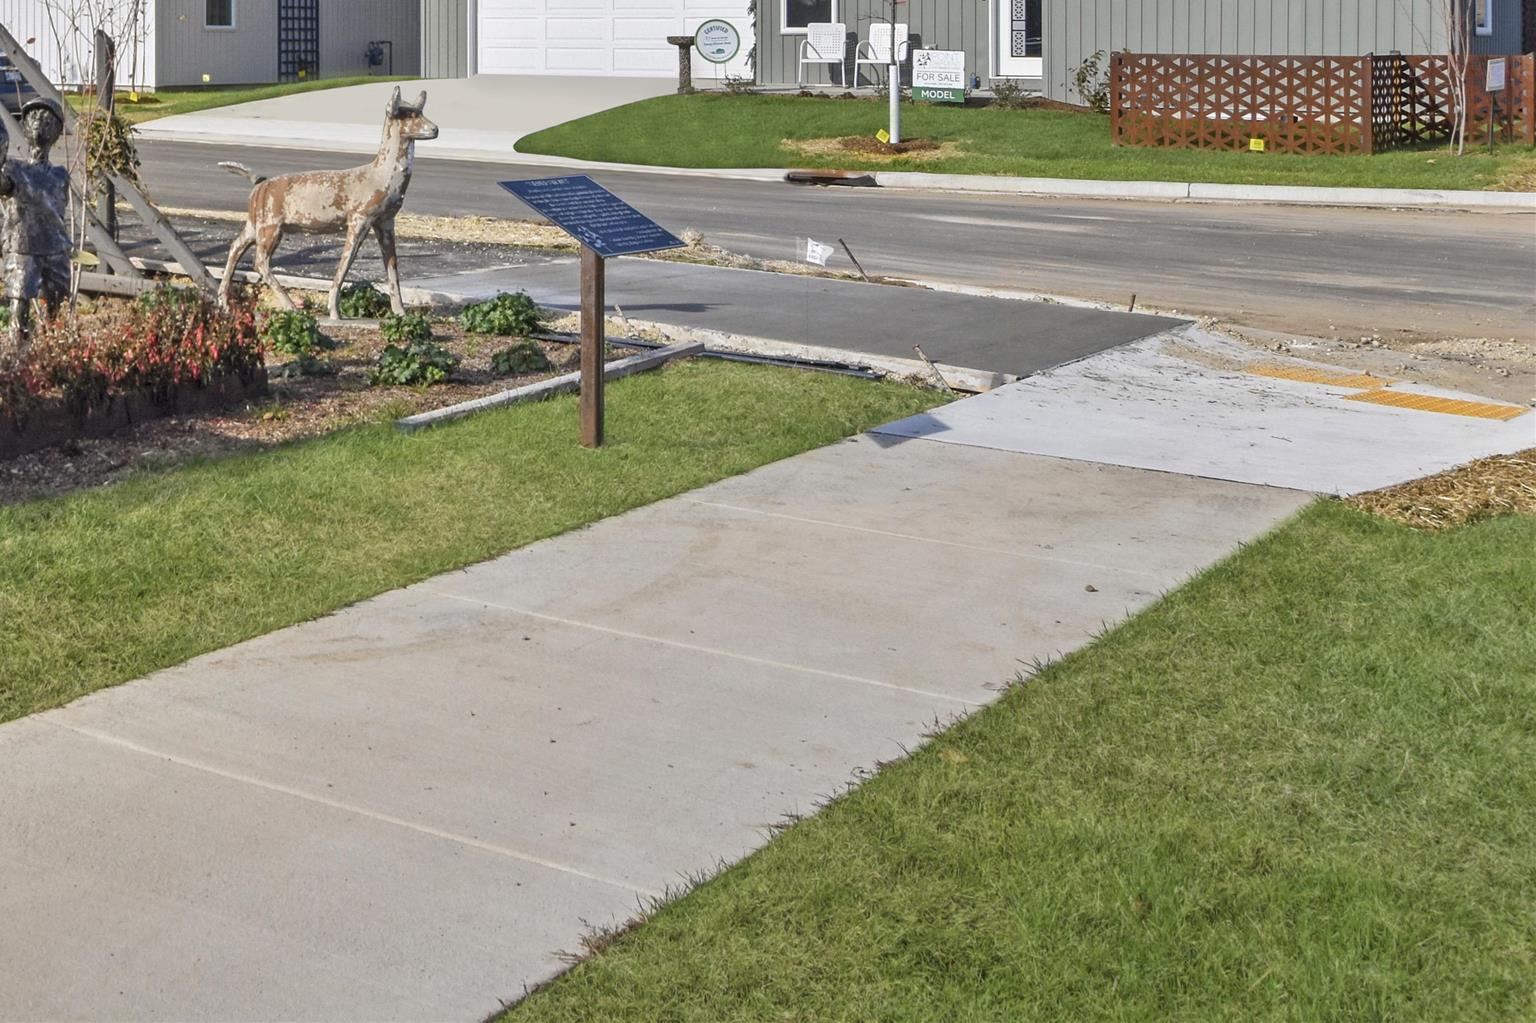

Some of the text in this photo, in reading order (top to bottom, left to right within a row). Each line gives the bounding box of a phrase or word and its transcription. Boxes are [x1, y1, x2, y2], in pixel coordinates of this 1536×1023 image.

[916, 72, 960, 83] FOR SALE
[921, 89, 955, 99] MODEL
